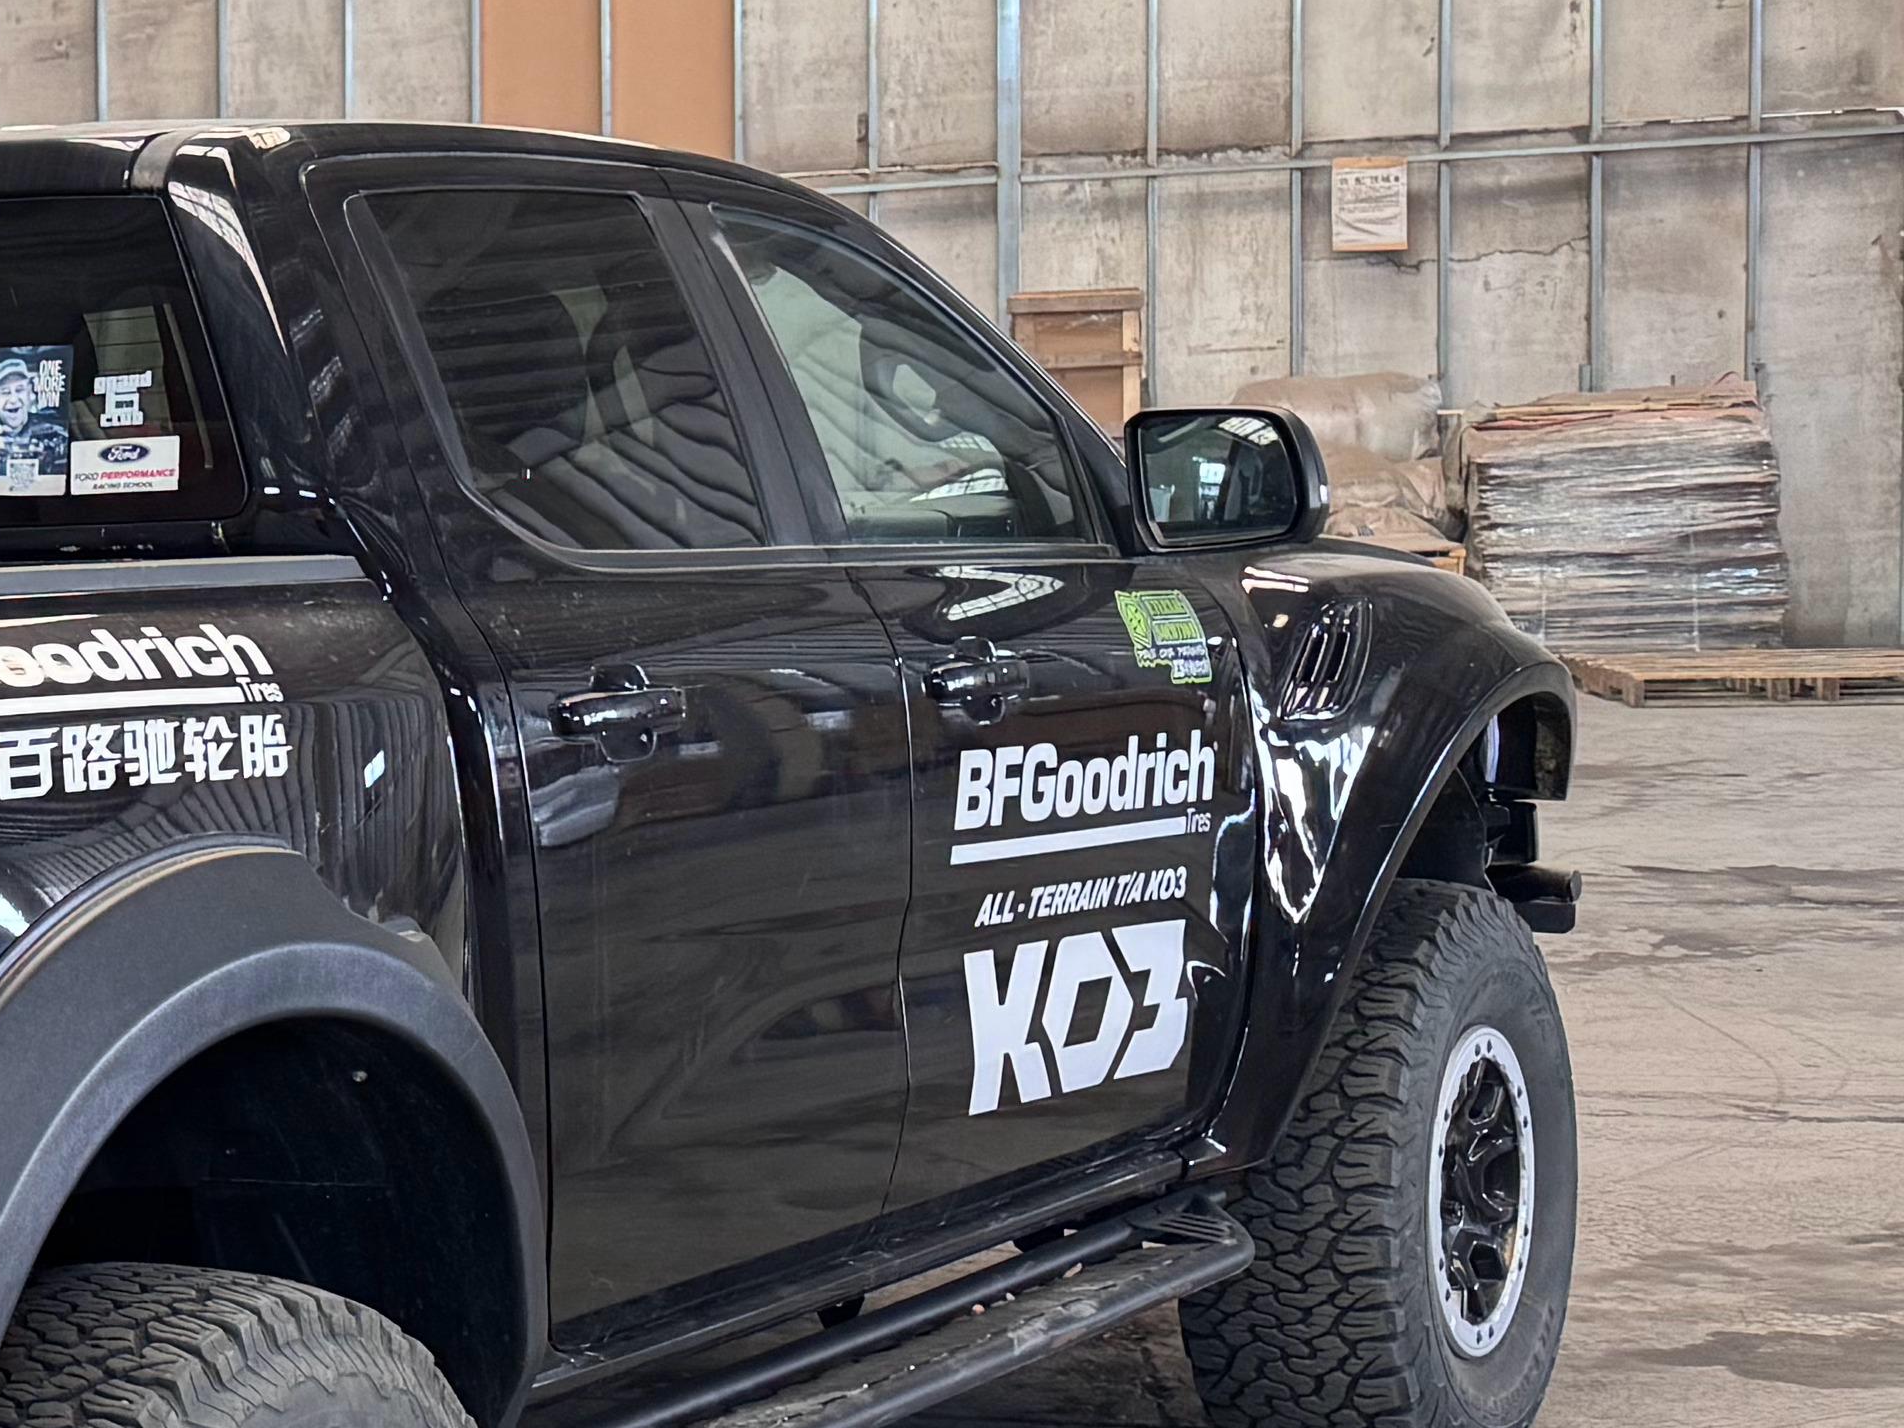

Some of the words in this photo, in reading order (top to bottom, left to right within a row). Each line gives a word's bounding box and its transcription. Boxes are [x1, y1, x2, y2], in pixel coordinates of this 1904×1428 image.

[39, 360, 63, 374] ONE
[34, 374, 66, 391] MORE
[37, 391, 60, 409] WIN
[74, 472, 99, 482] FORD
[100, 468, 176, 480] PERFORMANCE
[123, 481, 154, 489] SCHOOL
[236, 676, 284, 703] Tires
[954, 729, 1216, 831] BFGoodrich
[1186, 807, 1212, 834] Tires
[1143, 865, 1188, 903] KO3
[963, 919, 1189, 1116] KO3
